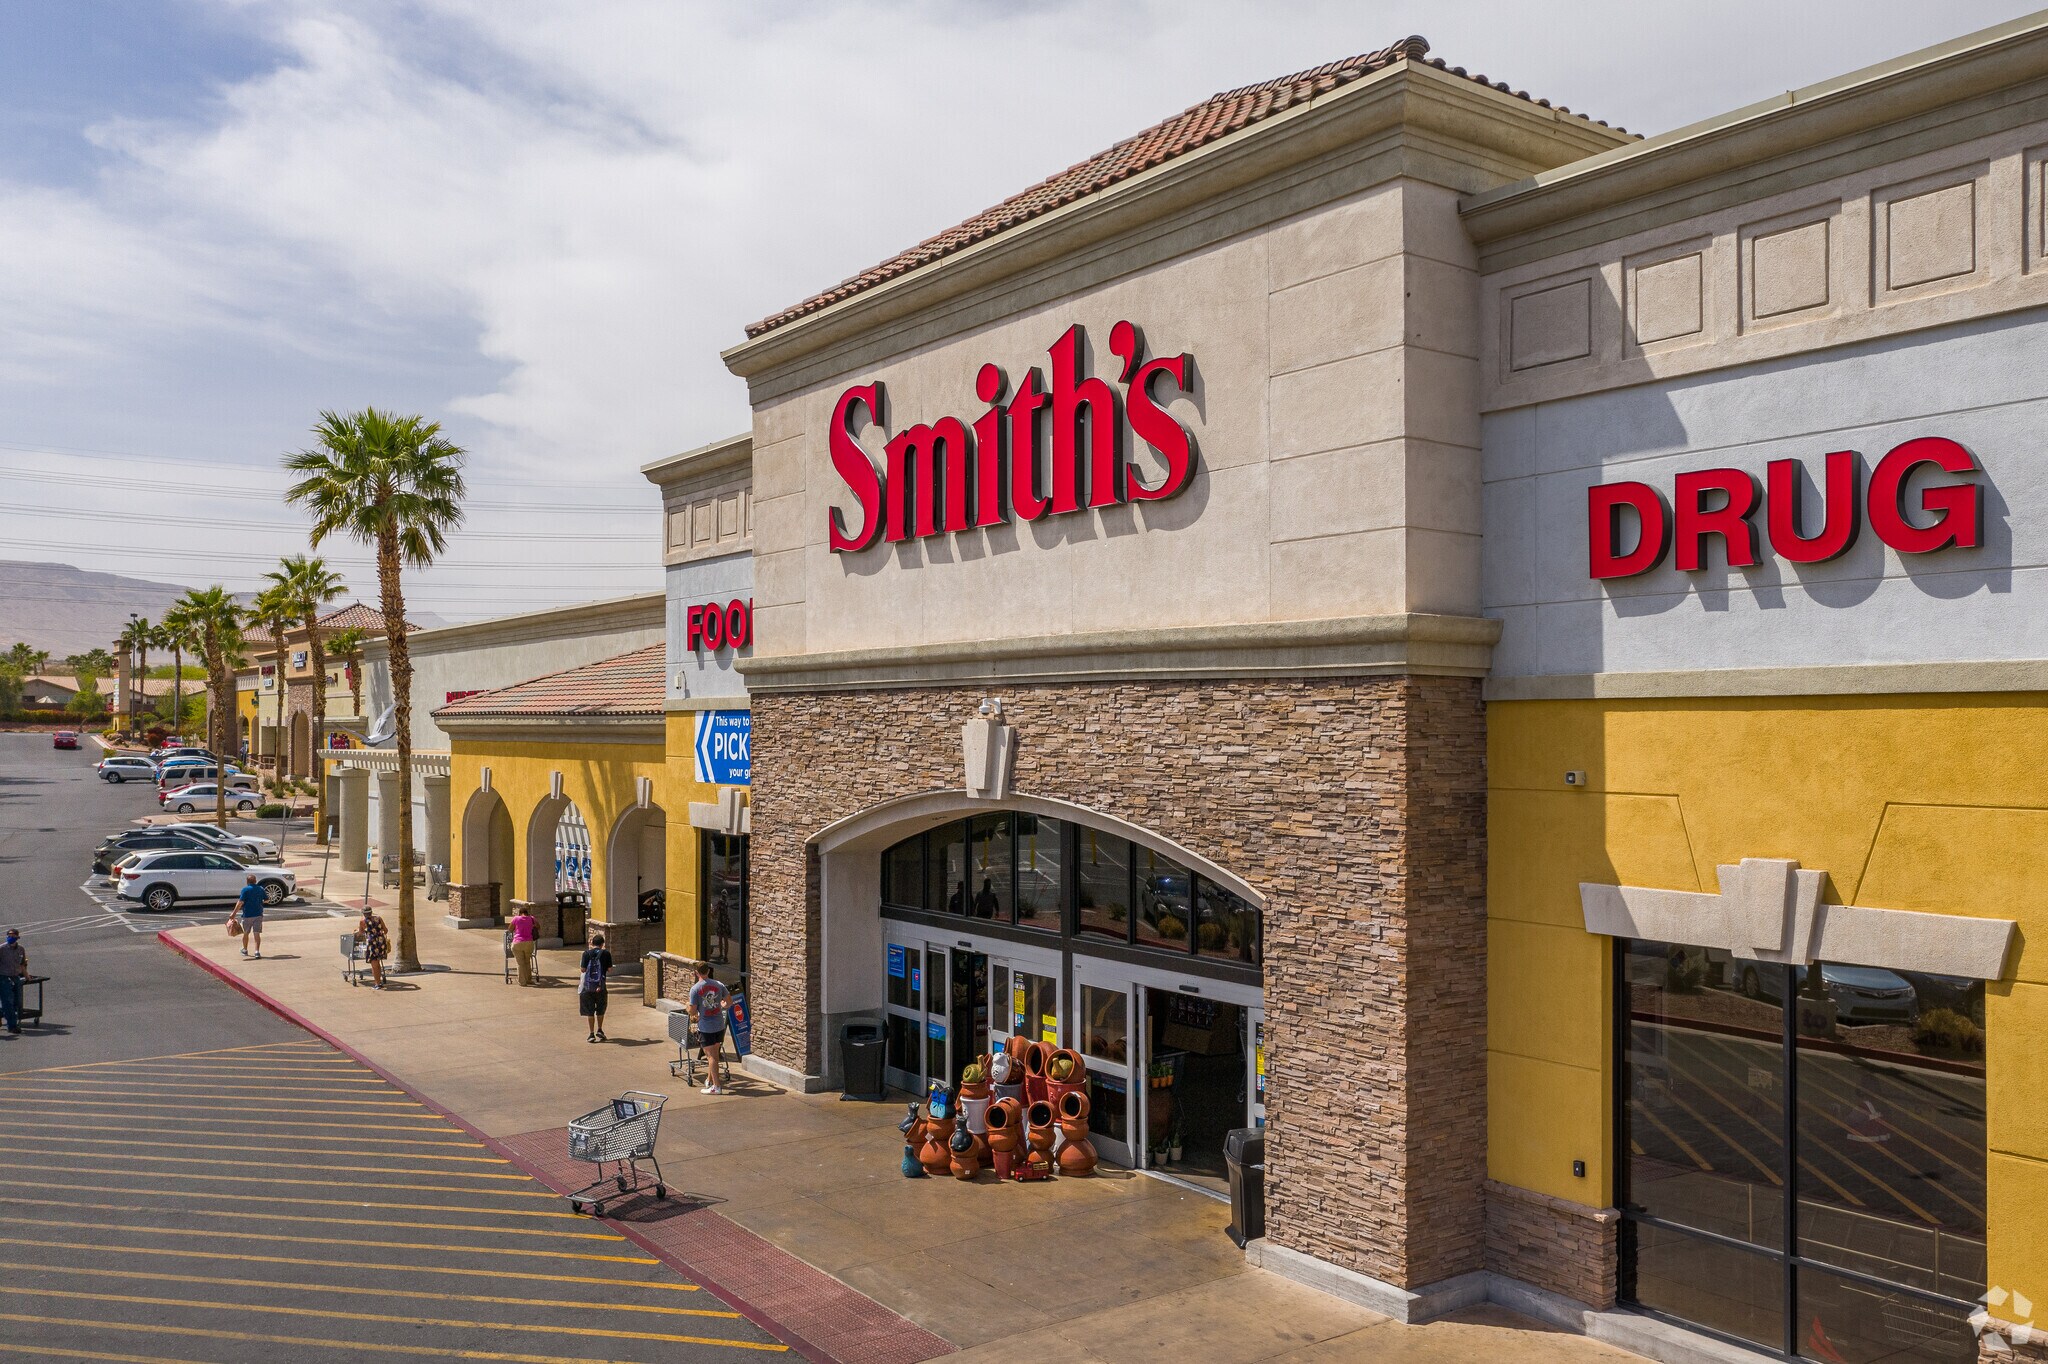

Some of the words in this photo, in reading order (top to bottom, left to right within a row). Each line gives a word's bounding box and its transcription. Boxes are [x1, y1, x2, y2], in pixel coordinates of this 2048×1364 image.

[829, 320, 1199, 554] Smith's
[1588, 437, 1984, 579] DRUG
[687, 597, 753, 652] FOO
[715, 716, 728, 726] This
[729, 718, 741, 729] way
[742, 716, 750, 726] to
[714, 732, 750, 761] PICK
[729, 768, 743, 778] your
